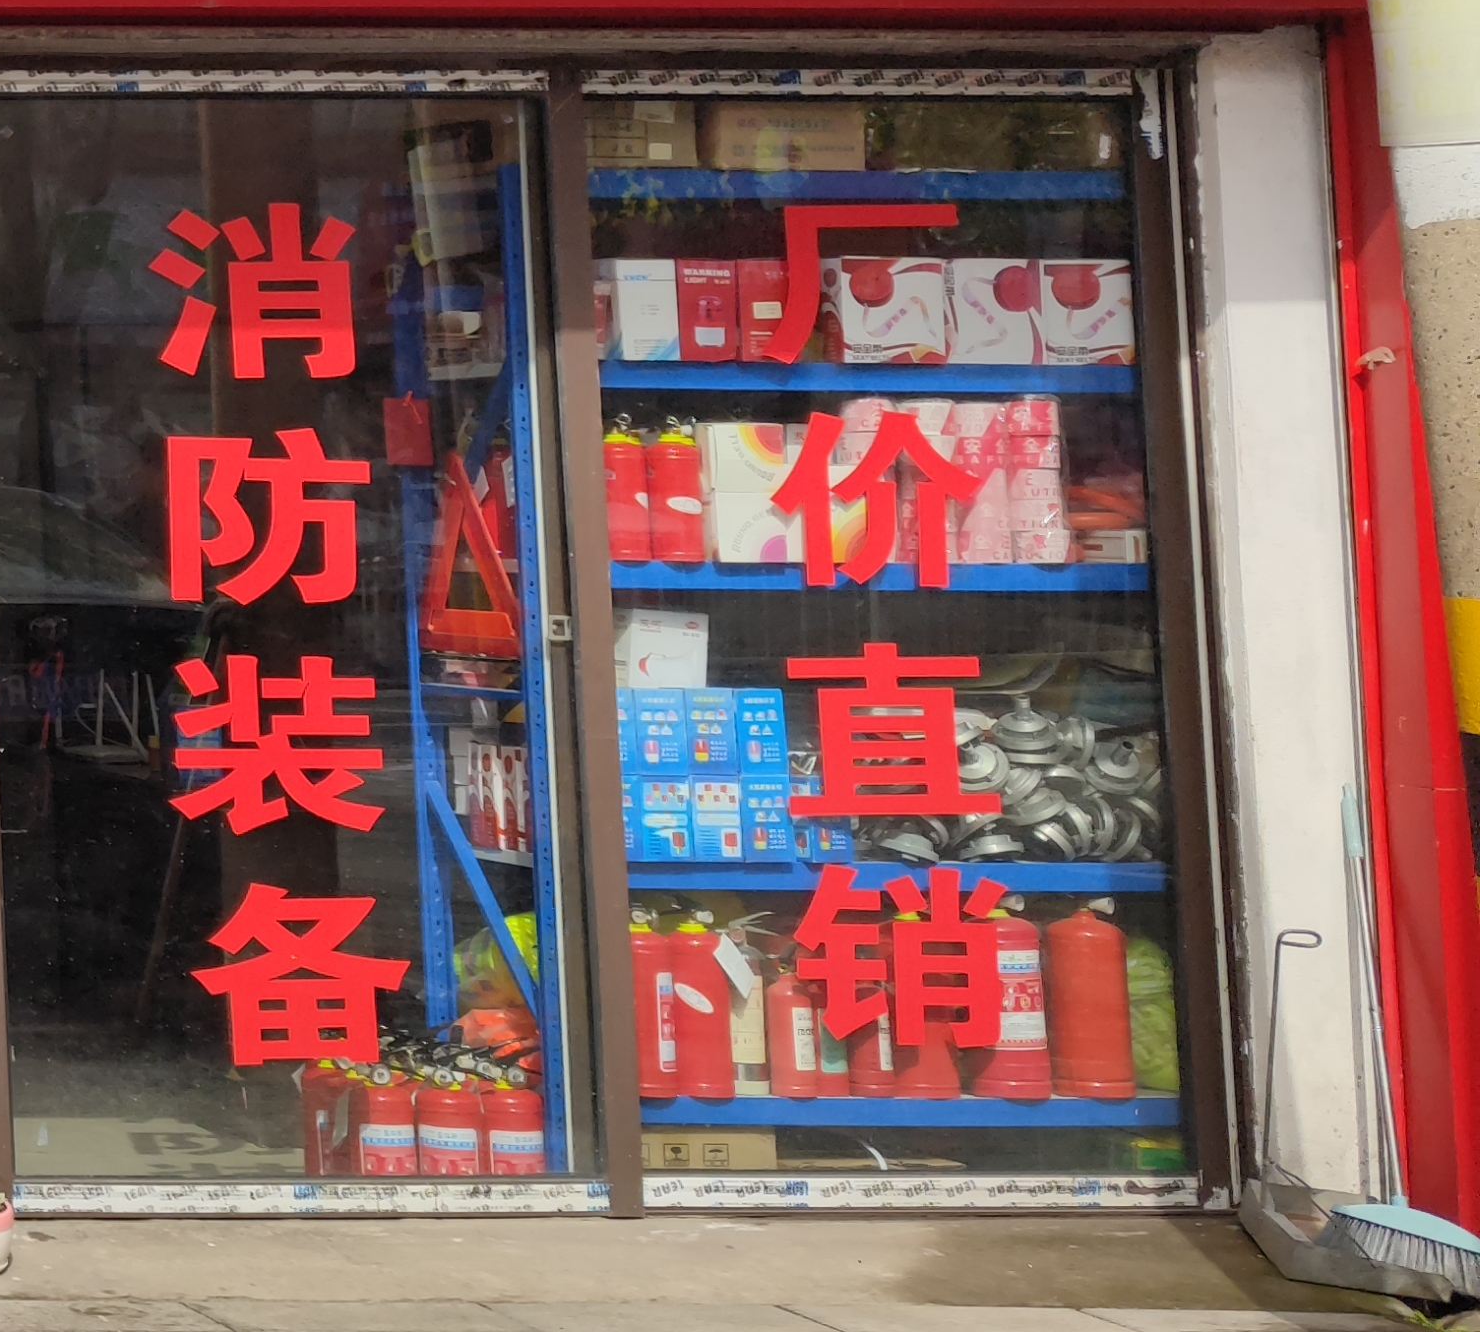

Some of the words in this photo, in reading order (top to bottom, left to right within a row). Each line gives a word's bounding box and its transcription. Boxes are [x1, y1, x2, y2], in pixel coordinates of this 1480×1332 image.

[147, 202, 412, 1067] 消防装备
[683, 268, 731, 277] WARNING
[761, 203, 1009, 1050] 厂价直销
